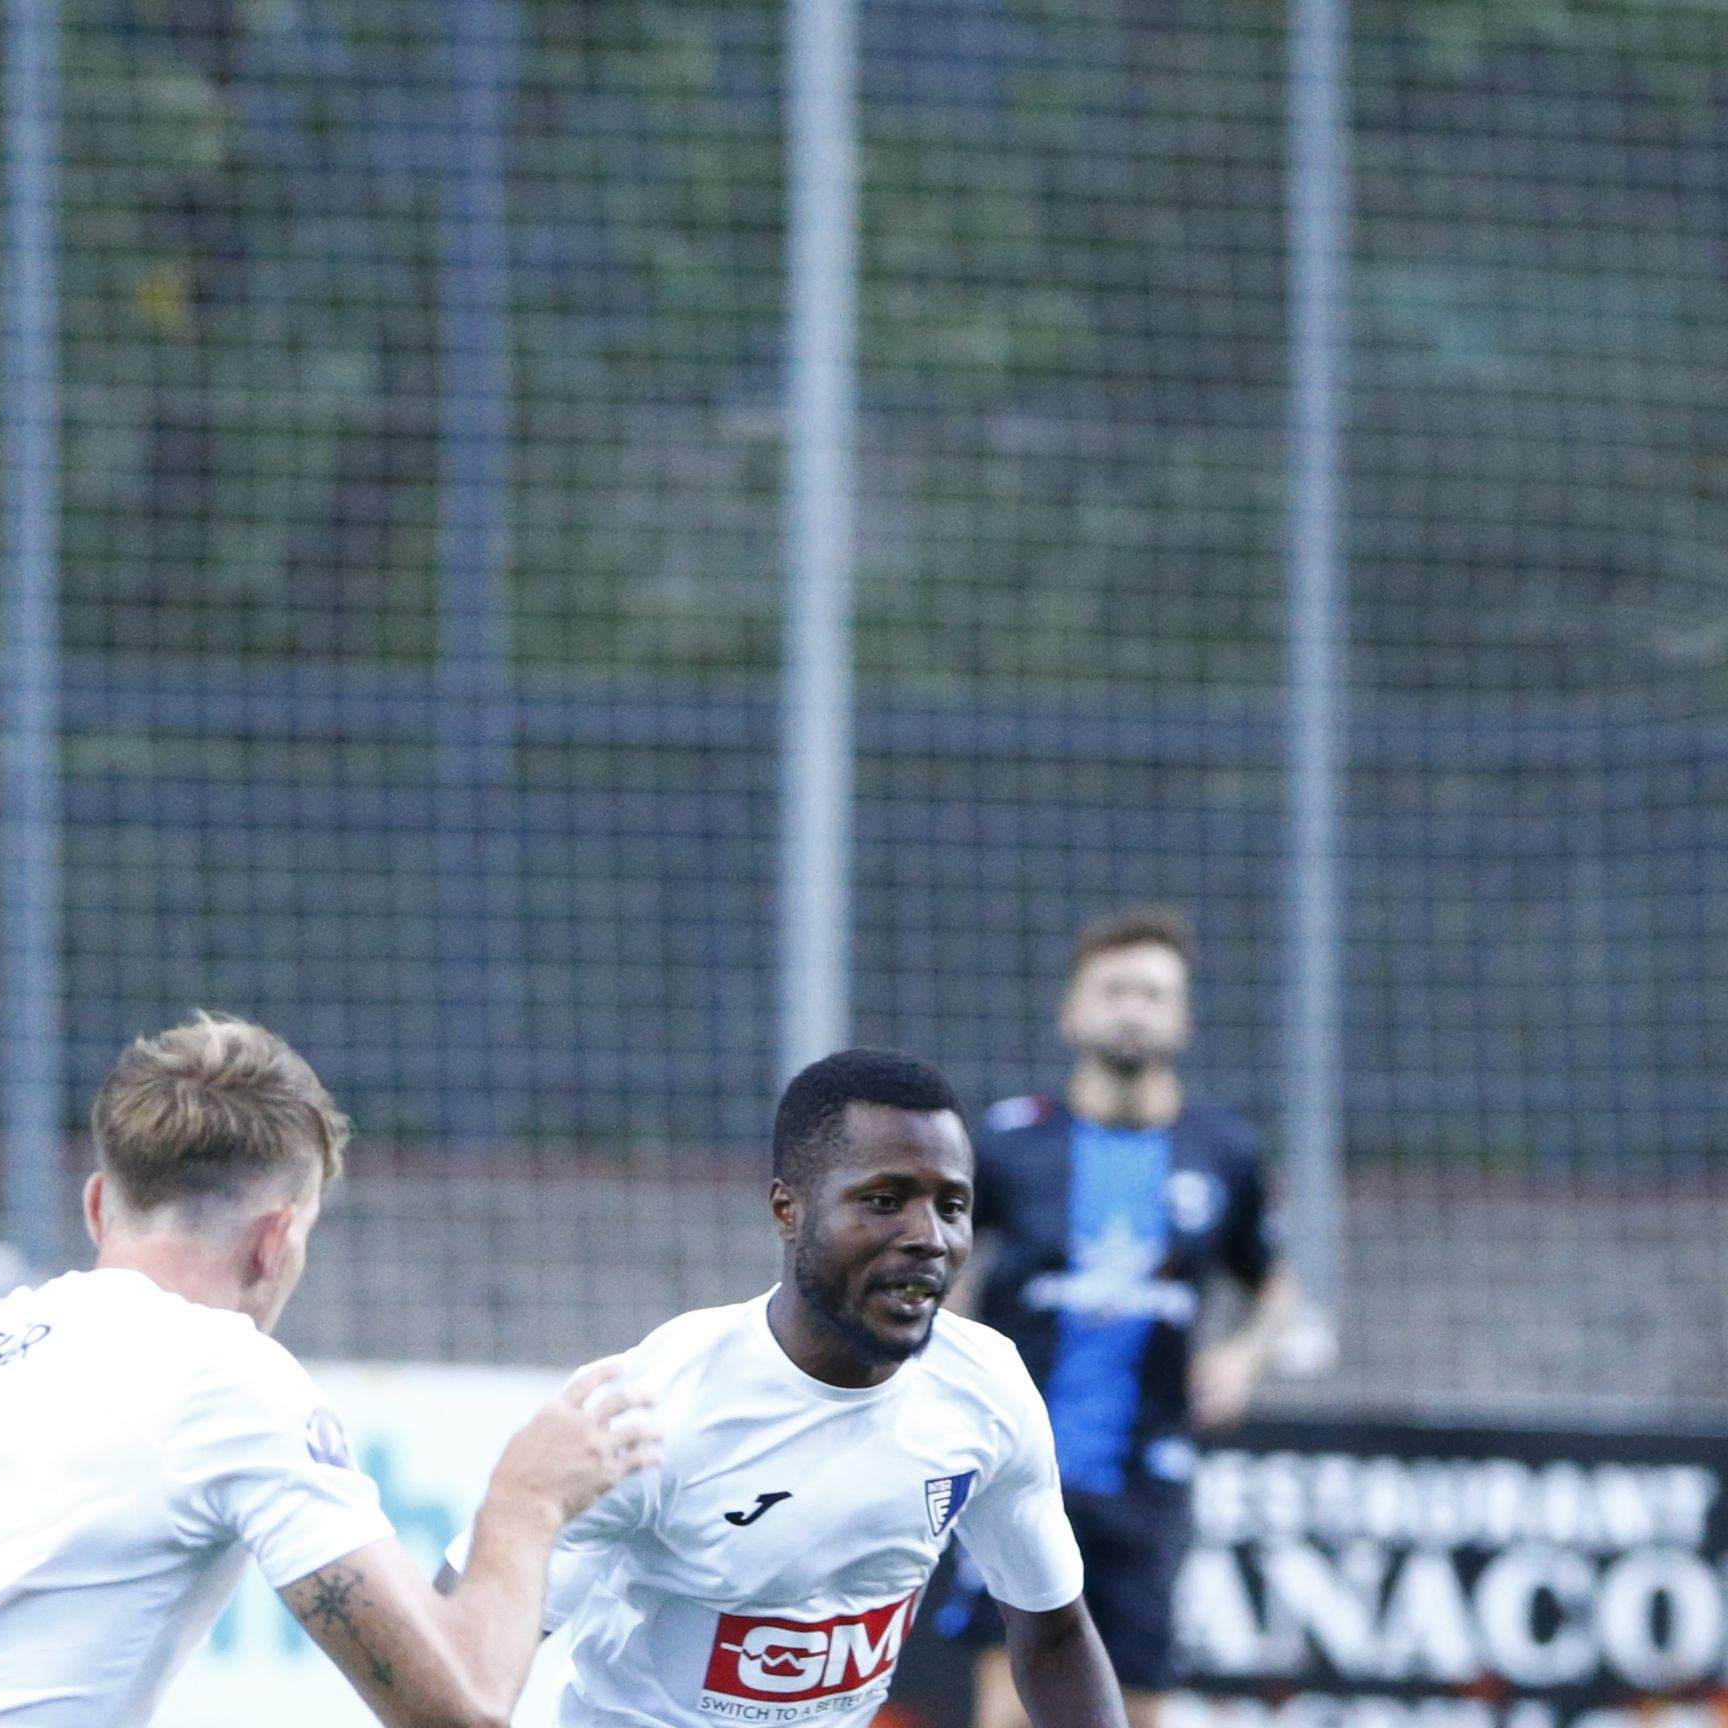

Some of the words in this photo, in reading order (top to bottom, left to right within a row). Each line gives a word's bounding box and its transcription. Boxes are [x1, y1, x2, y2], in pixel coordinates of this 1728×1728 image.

[1193, 1450, 1717, 1543] ESTAURANT
[721, 1598, 911, 1694] GM
[700, 1696, 769, 1721] SWITCH
[776, 1707, 798, 1721] TO
